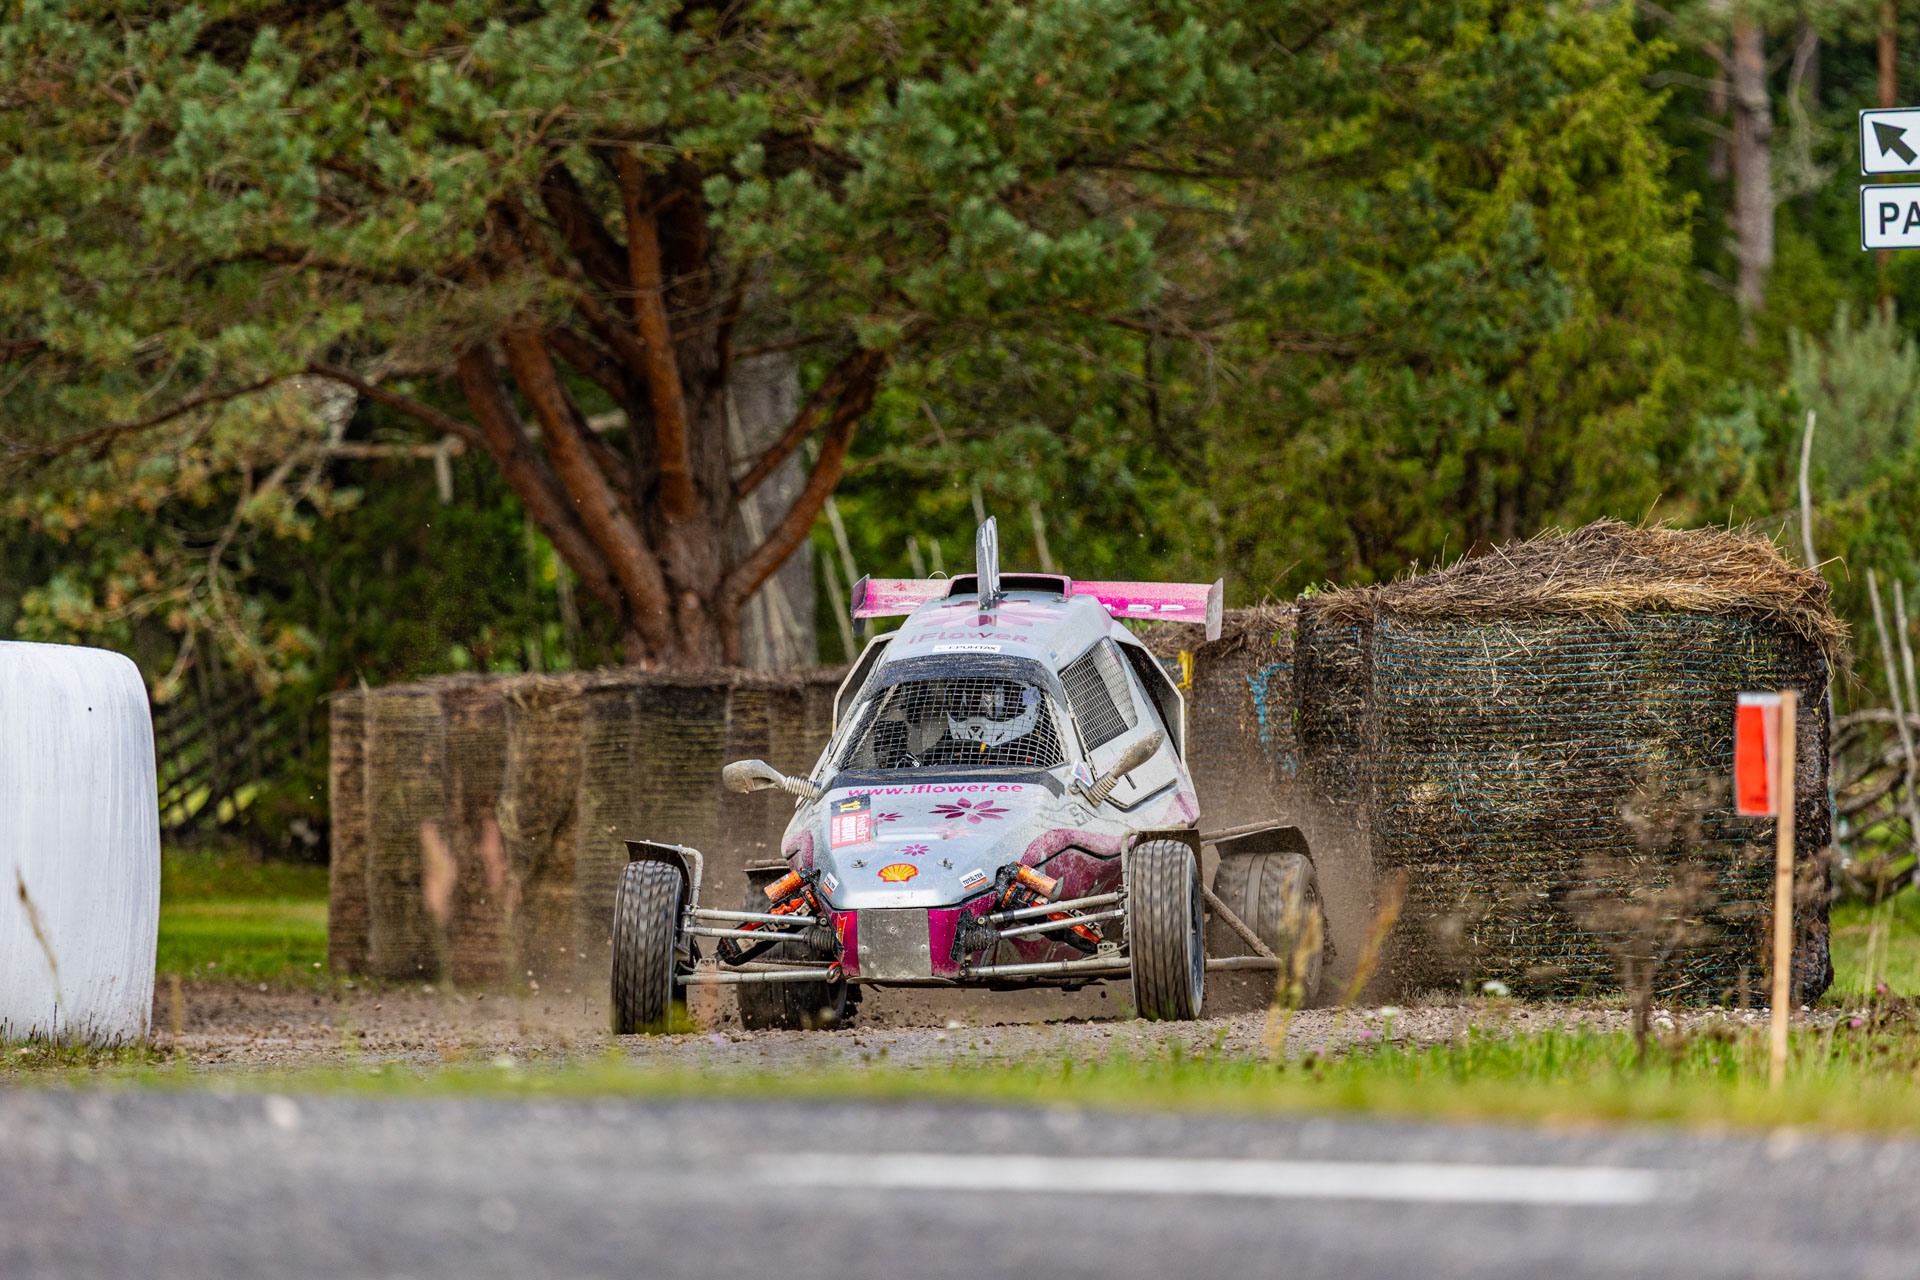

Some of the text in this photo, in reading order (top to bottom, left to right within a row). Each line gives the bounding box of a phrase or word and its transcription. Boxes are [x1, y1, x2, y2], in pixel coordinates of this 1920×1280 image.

[1879, 201, 1920, 235] PA
[848, 784, 1023, 797] www.iflower.ee
[840, 800, 861, 813] 12
